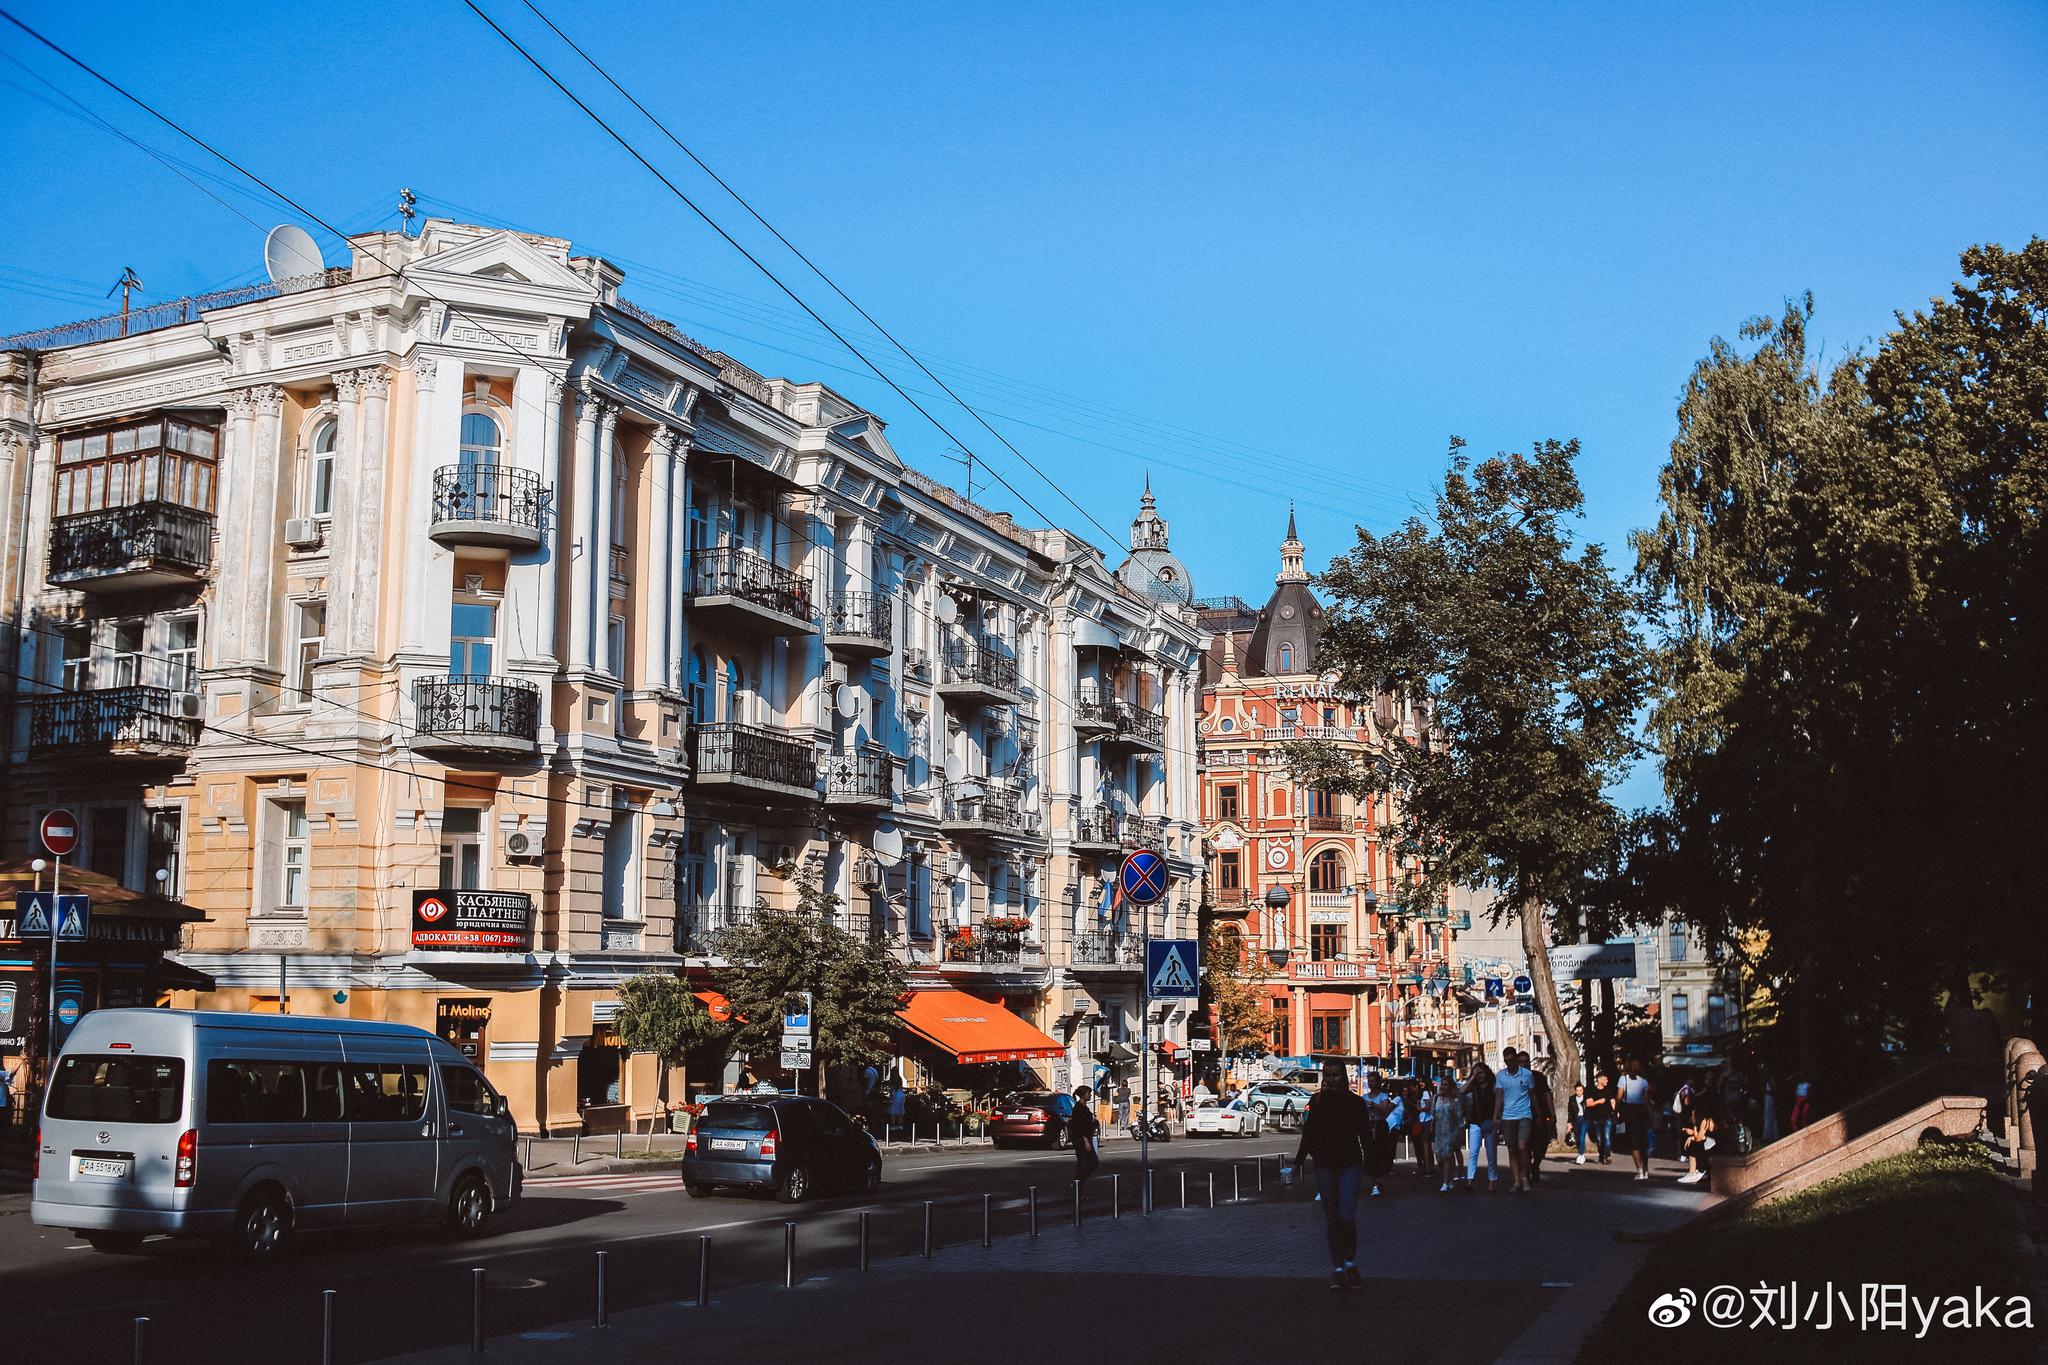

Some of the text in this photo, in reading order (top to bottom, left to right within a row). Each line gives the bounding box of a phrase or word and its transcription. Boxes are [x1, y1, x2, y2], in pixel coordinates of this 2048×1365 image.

[457, 895, 527, 909] КАСЬЯНЕНКО
[456, 921, 500, 929] юридична
[416, 933, 461, 942] АДВОКАТИ
[482, 934, 501, 944] (067)
[1551, 957, 1618, 968] ОЛОДИМИРСЬКА
[440, 1004, 491, 1017] il Molino
[85, 1162, 94, 1170] AA
[112, 1164, 123, 1175] KK
